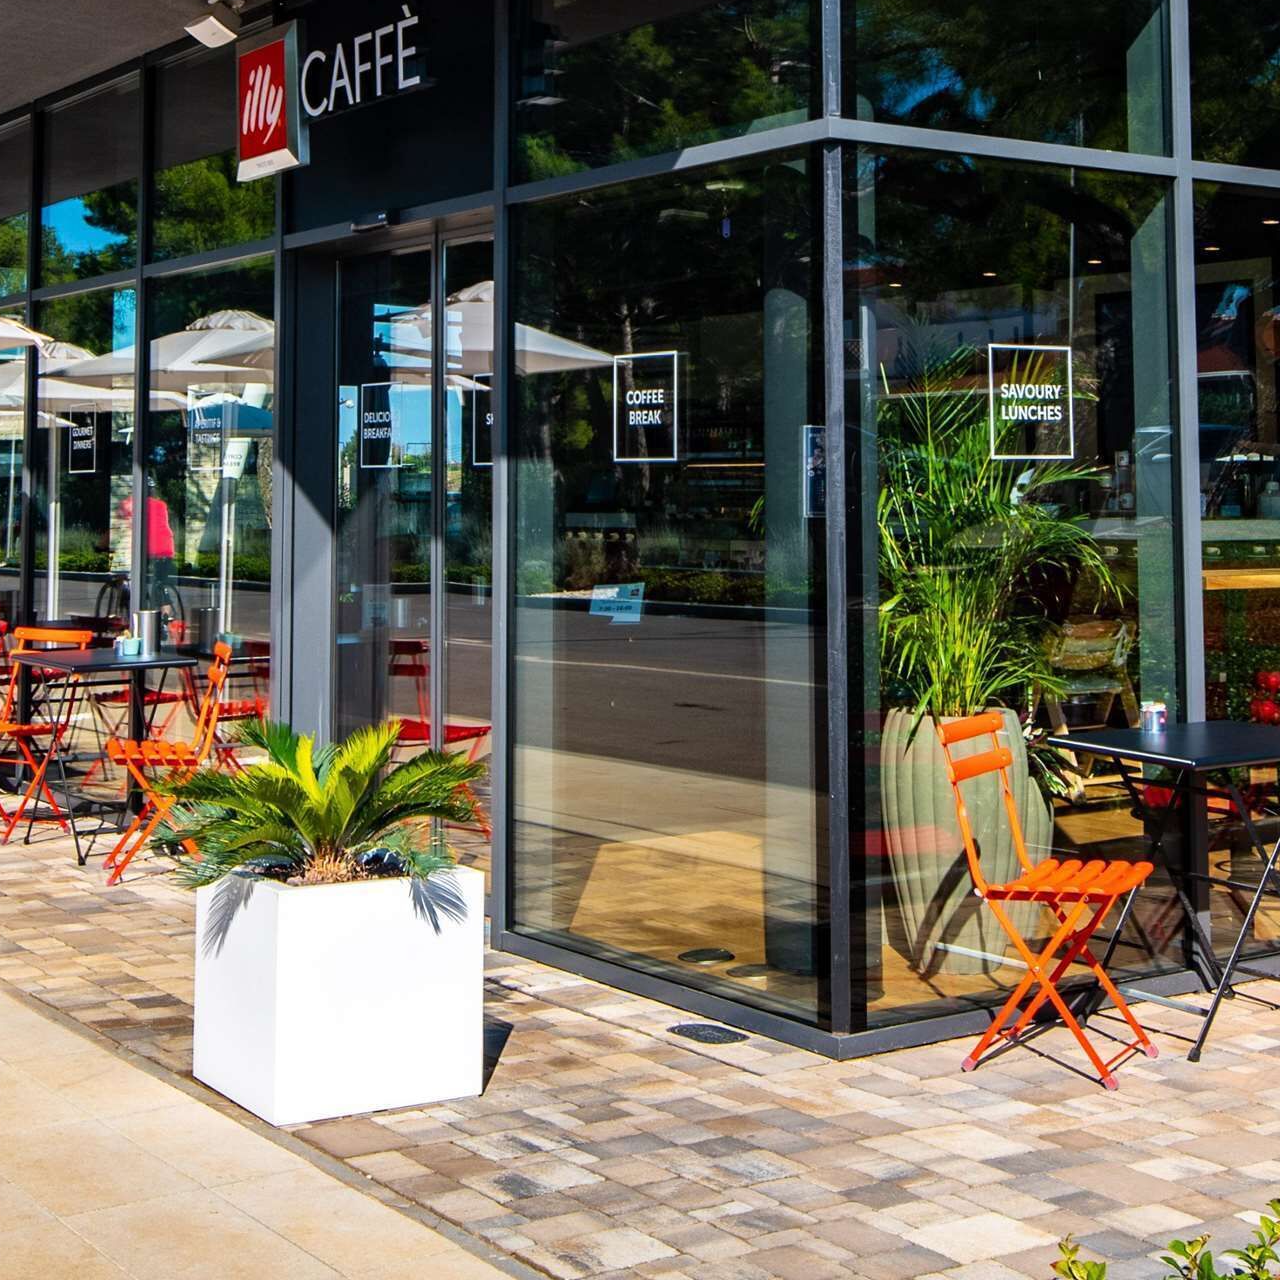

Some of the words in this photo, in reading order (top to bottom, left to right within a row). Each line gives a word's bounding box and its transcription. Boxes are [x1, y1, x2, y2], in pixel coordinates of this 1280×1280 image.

[242, 64, 284, 145] illy
[301, 3, 421, 117] CAFFÈ
[625, 389, 665, 405] COFFEE
[1000, 383, 1061, 399] SAVOURY
[629, 410, 662, 425] BREAK
[1001, 405, 1062, 420] LUNCHES
